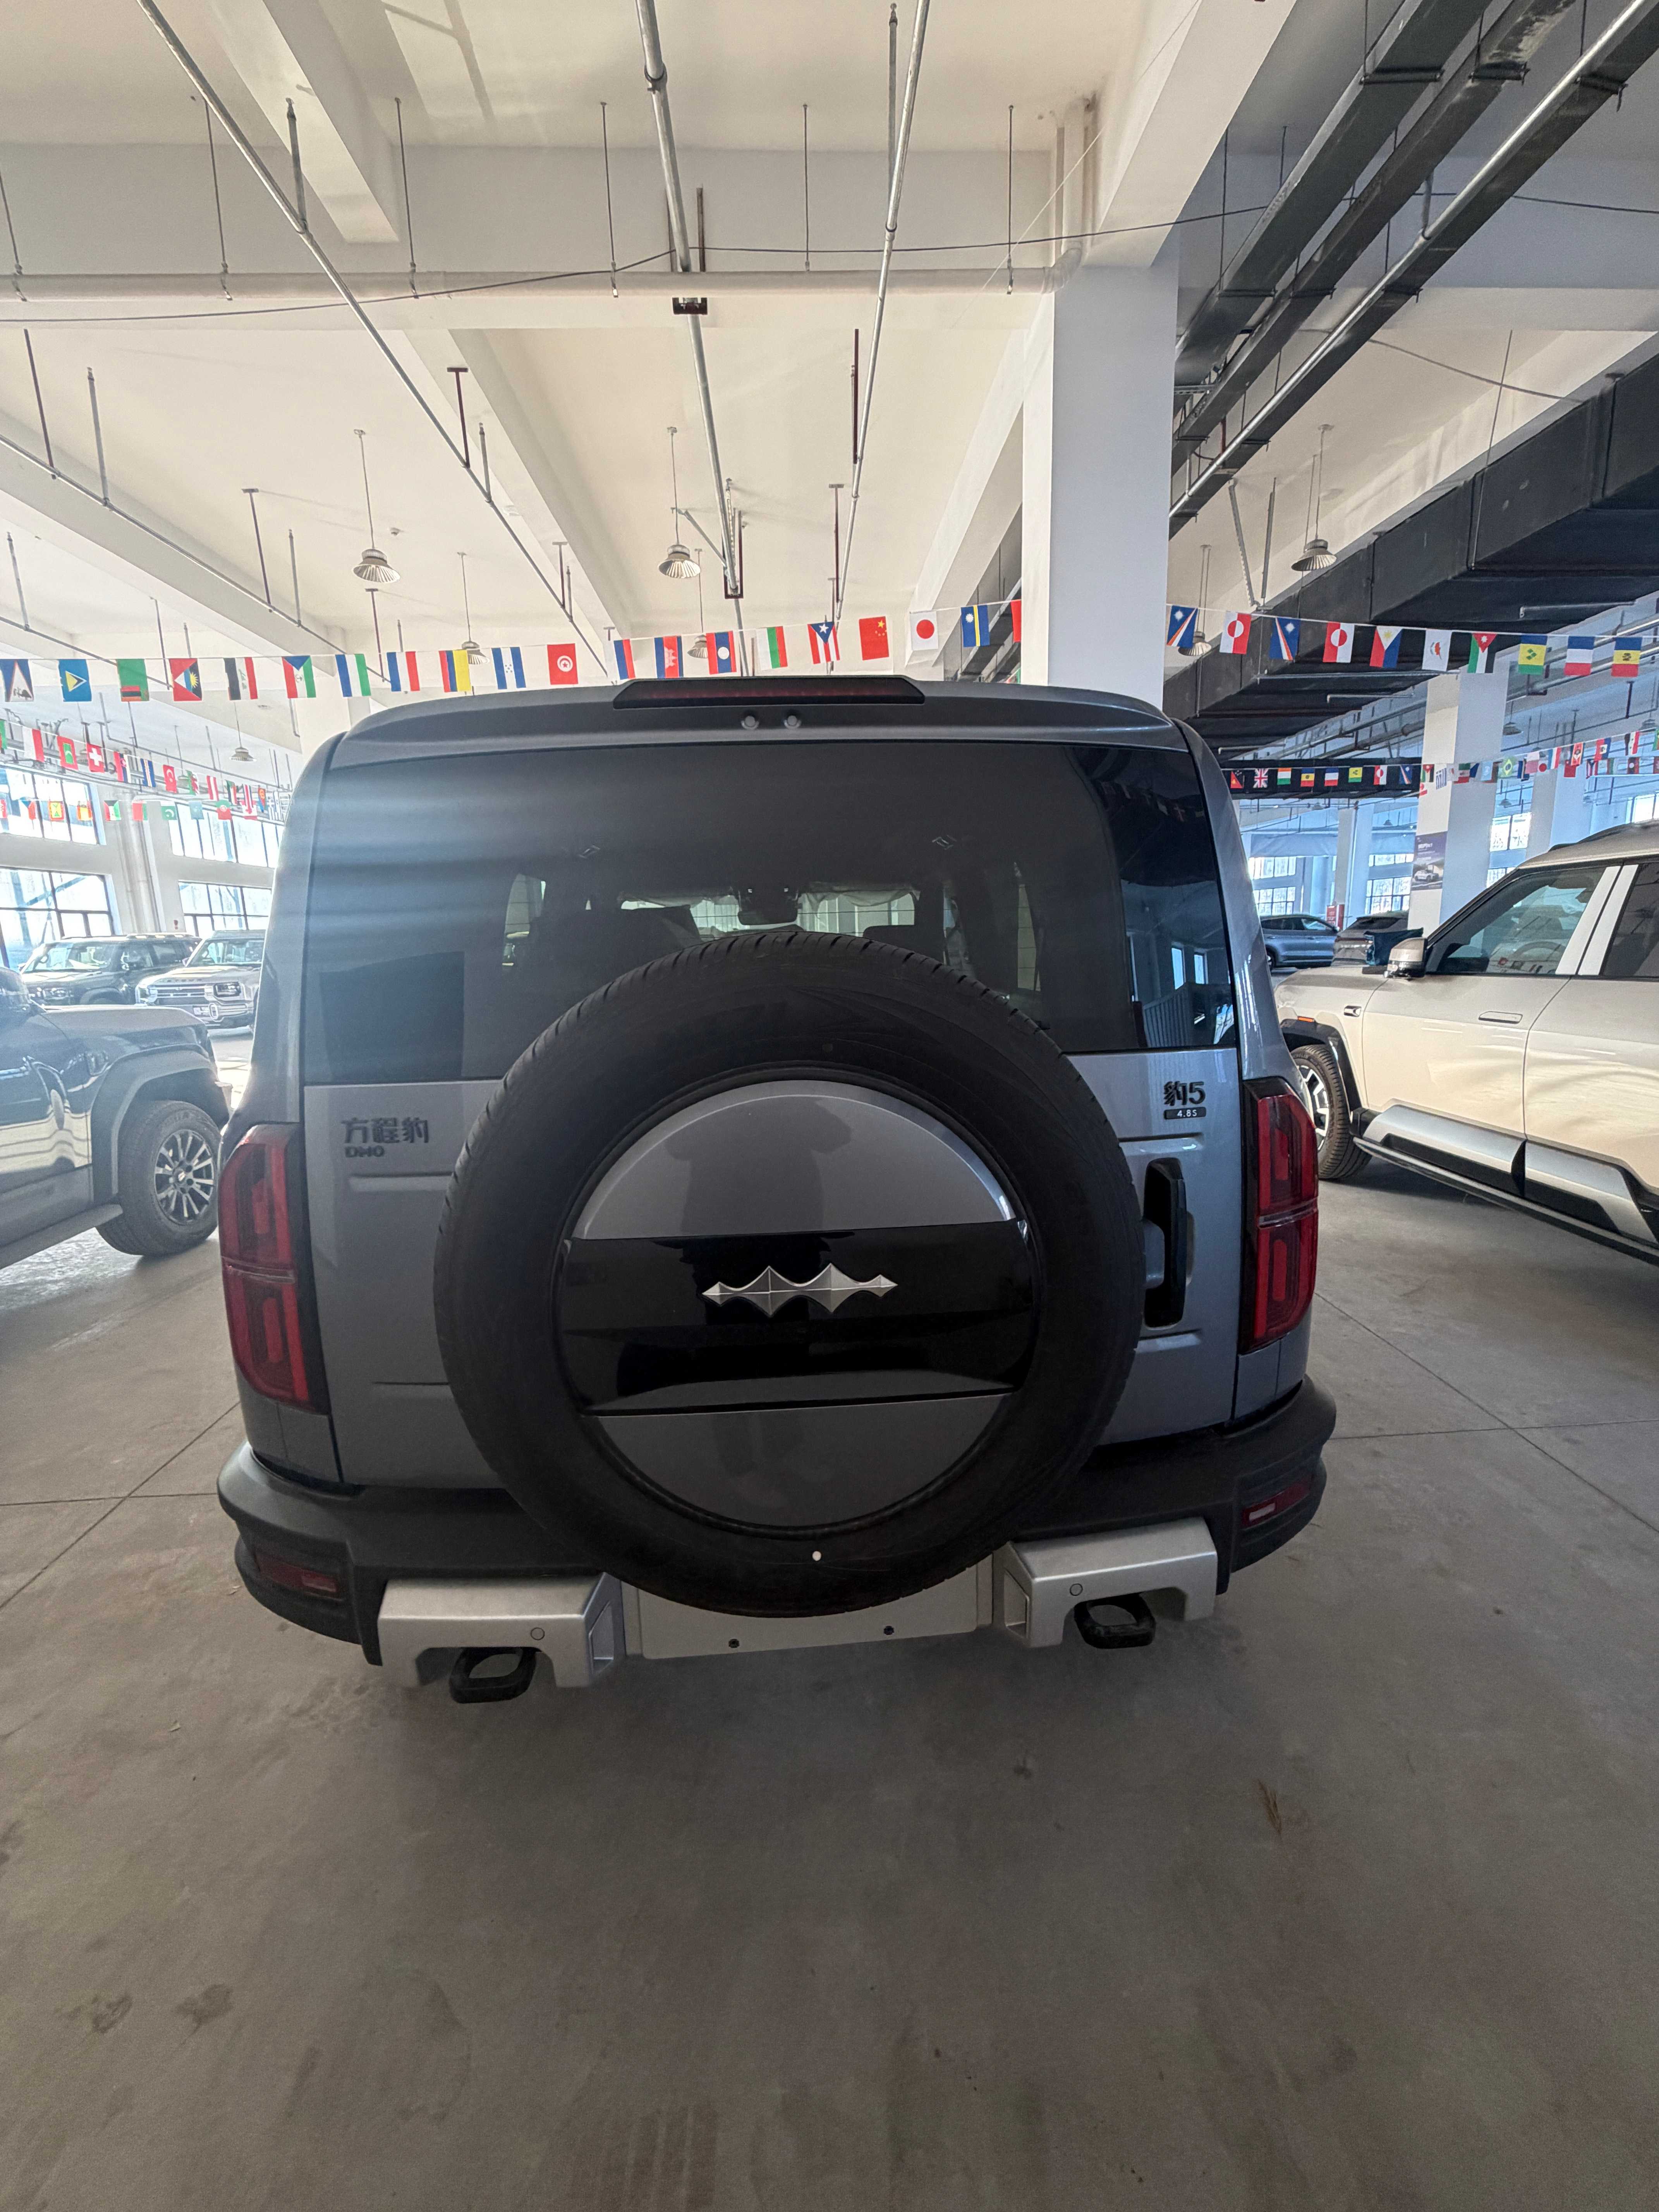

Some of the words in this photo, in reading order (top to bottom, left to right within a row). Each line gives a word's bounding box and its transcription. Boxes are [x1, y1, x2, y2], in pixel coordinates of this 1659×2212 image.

[1163, 1081, 1206, 1106] 豹5
[1177, 1109, 1197, 1118] 4.8S
[340, 1117, 429, 1143] 方程豹
